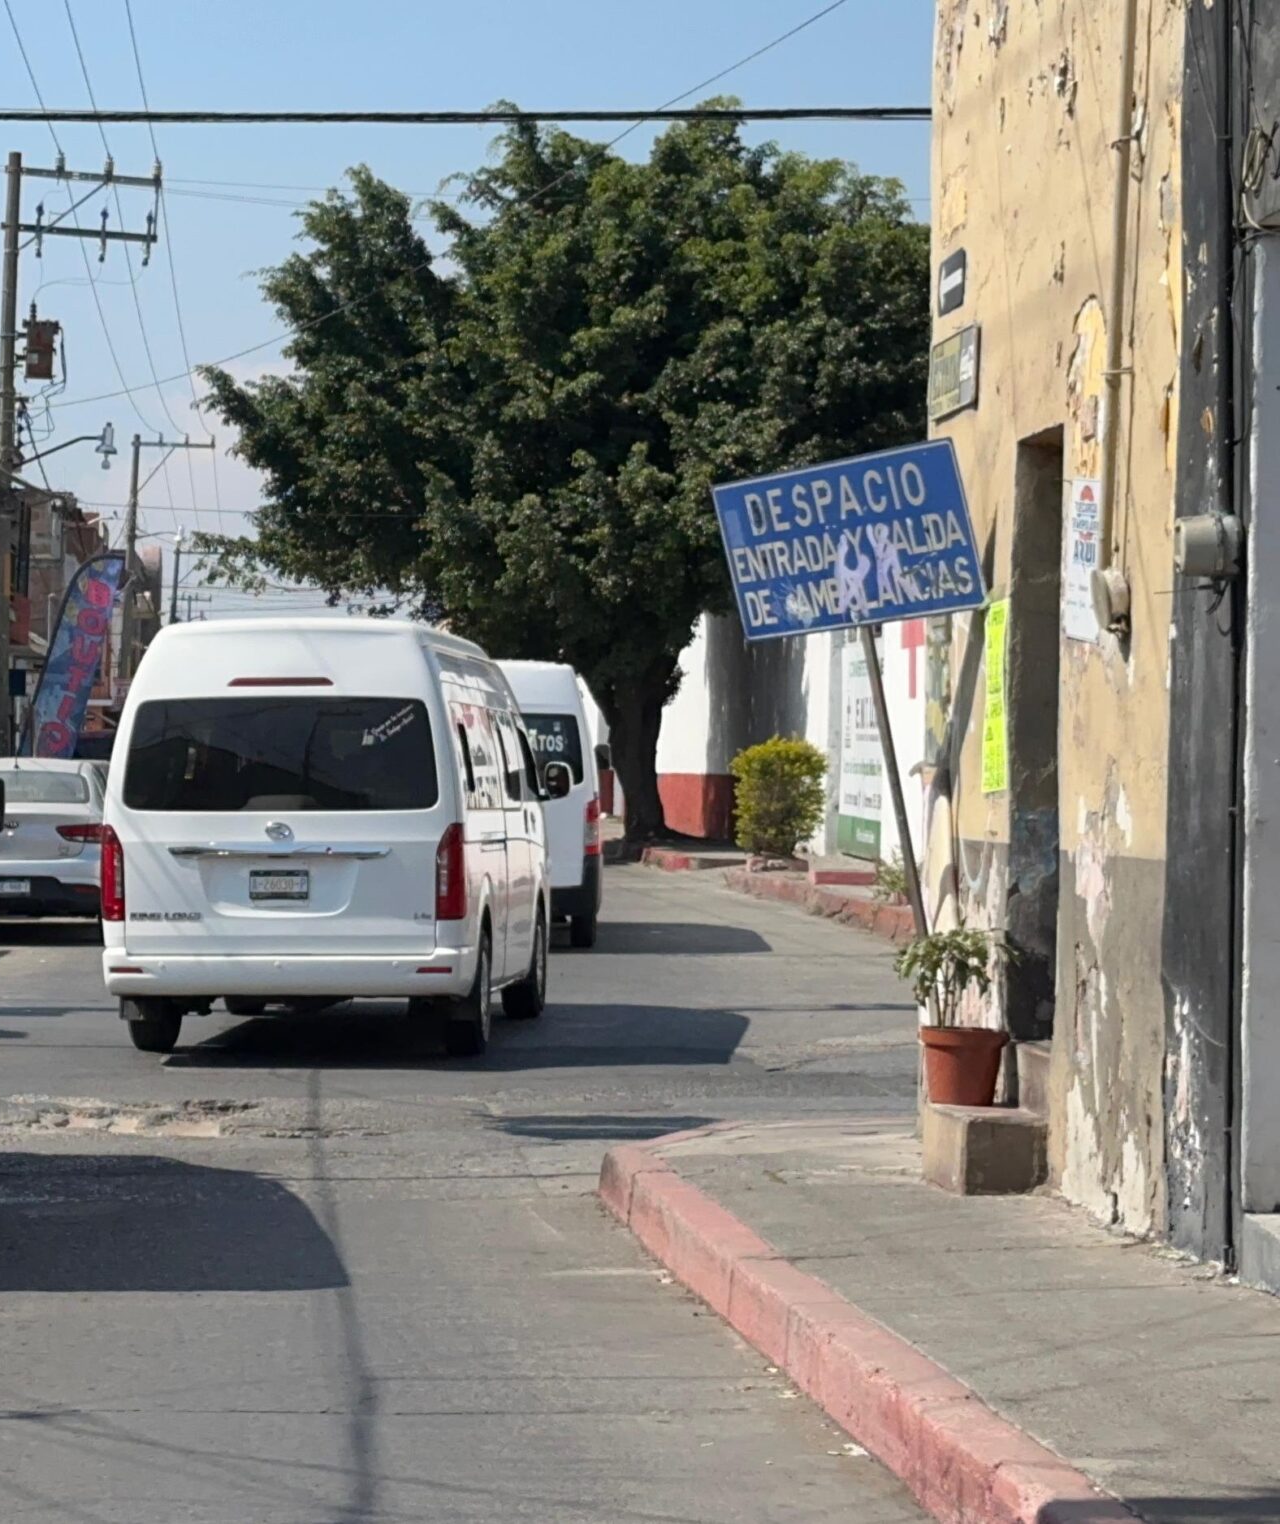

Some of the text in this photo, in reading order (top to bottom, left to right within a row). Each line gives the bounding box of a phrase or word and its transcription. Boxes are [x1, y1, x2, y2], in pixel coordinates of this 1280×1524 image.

[744, 462, 926, 537] DESPACIO
[731, 531, 840, 584] ENTRADA
[843, 526, 864, 558] Y
[744, 589, 779, 628] DE
